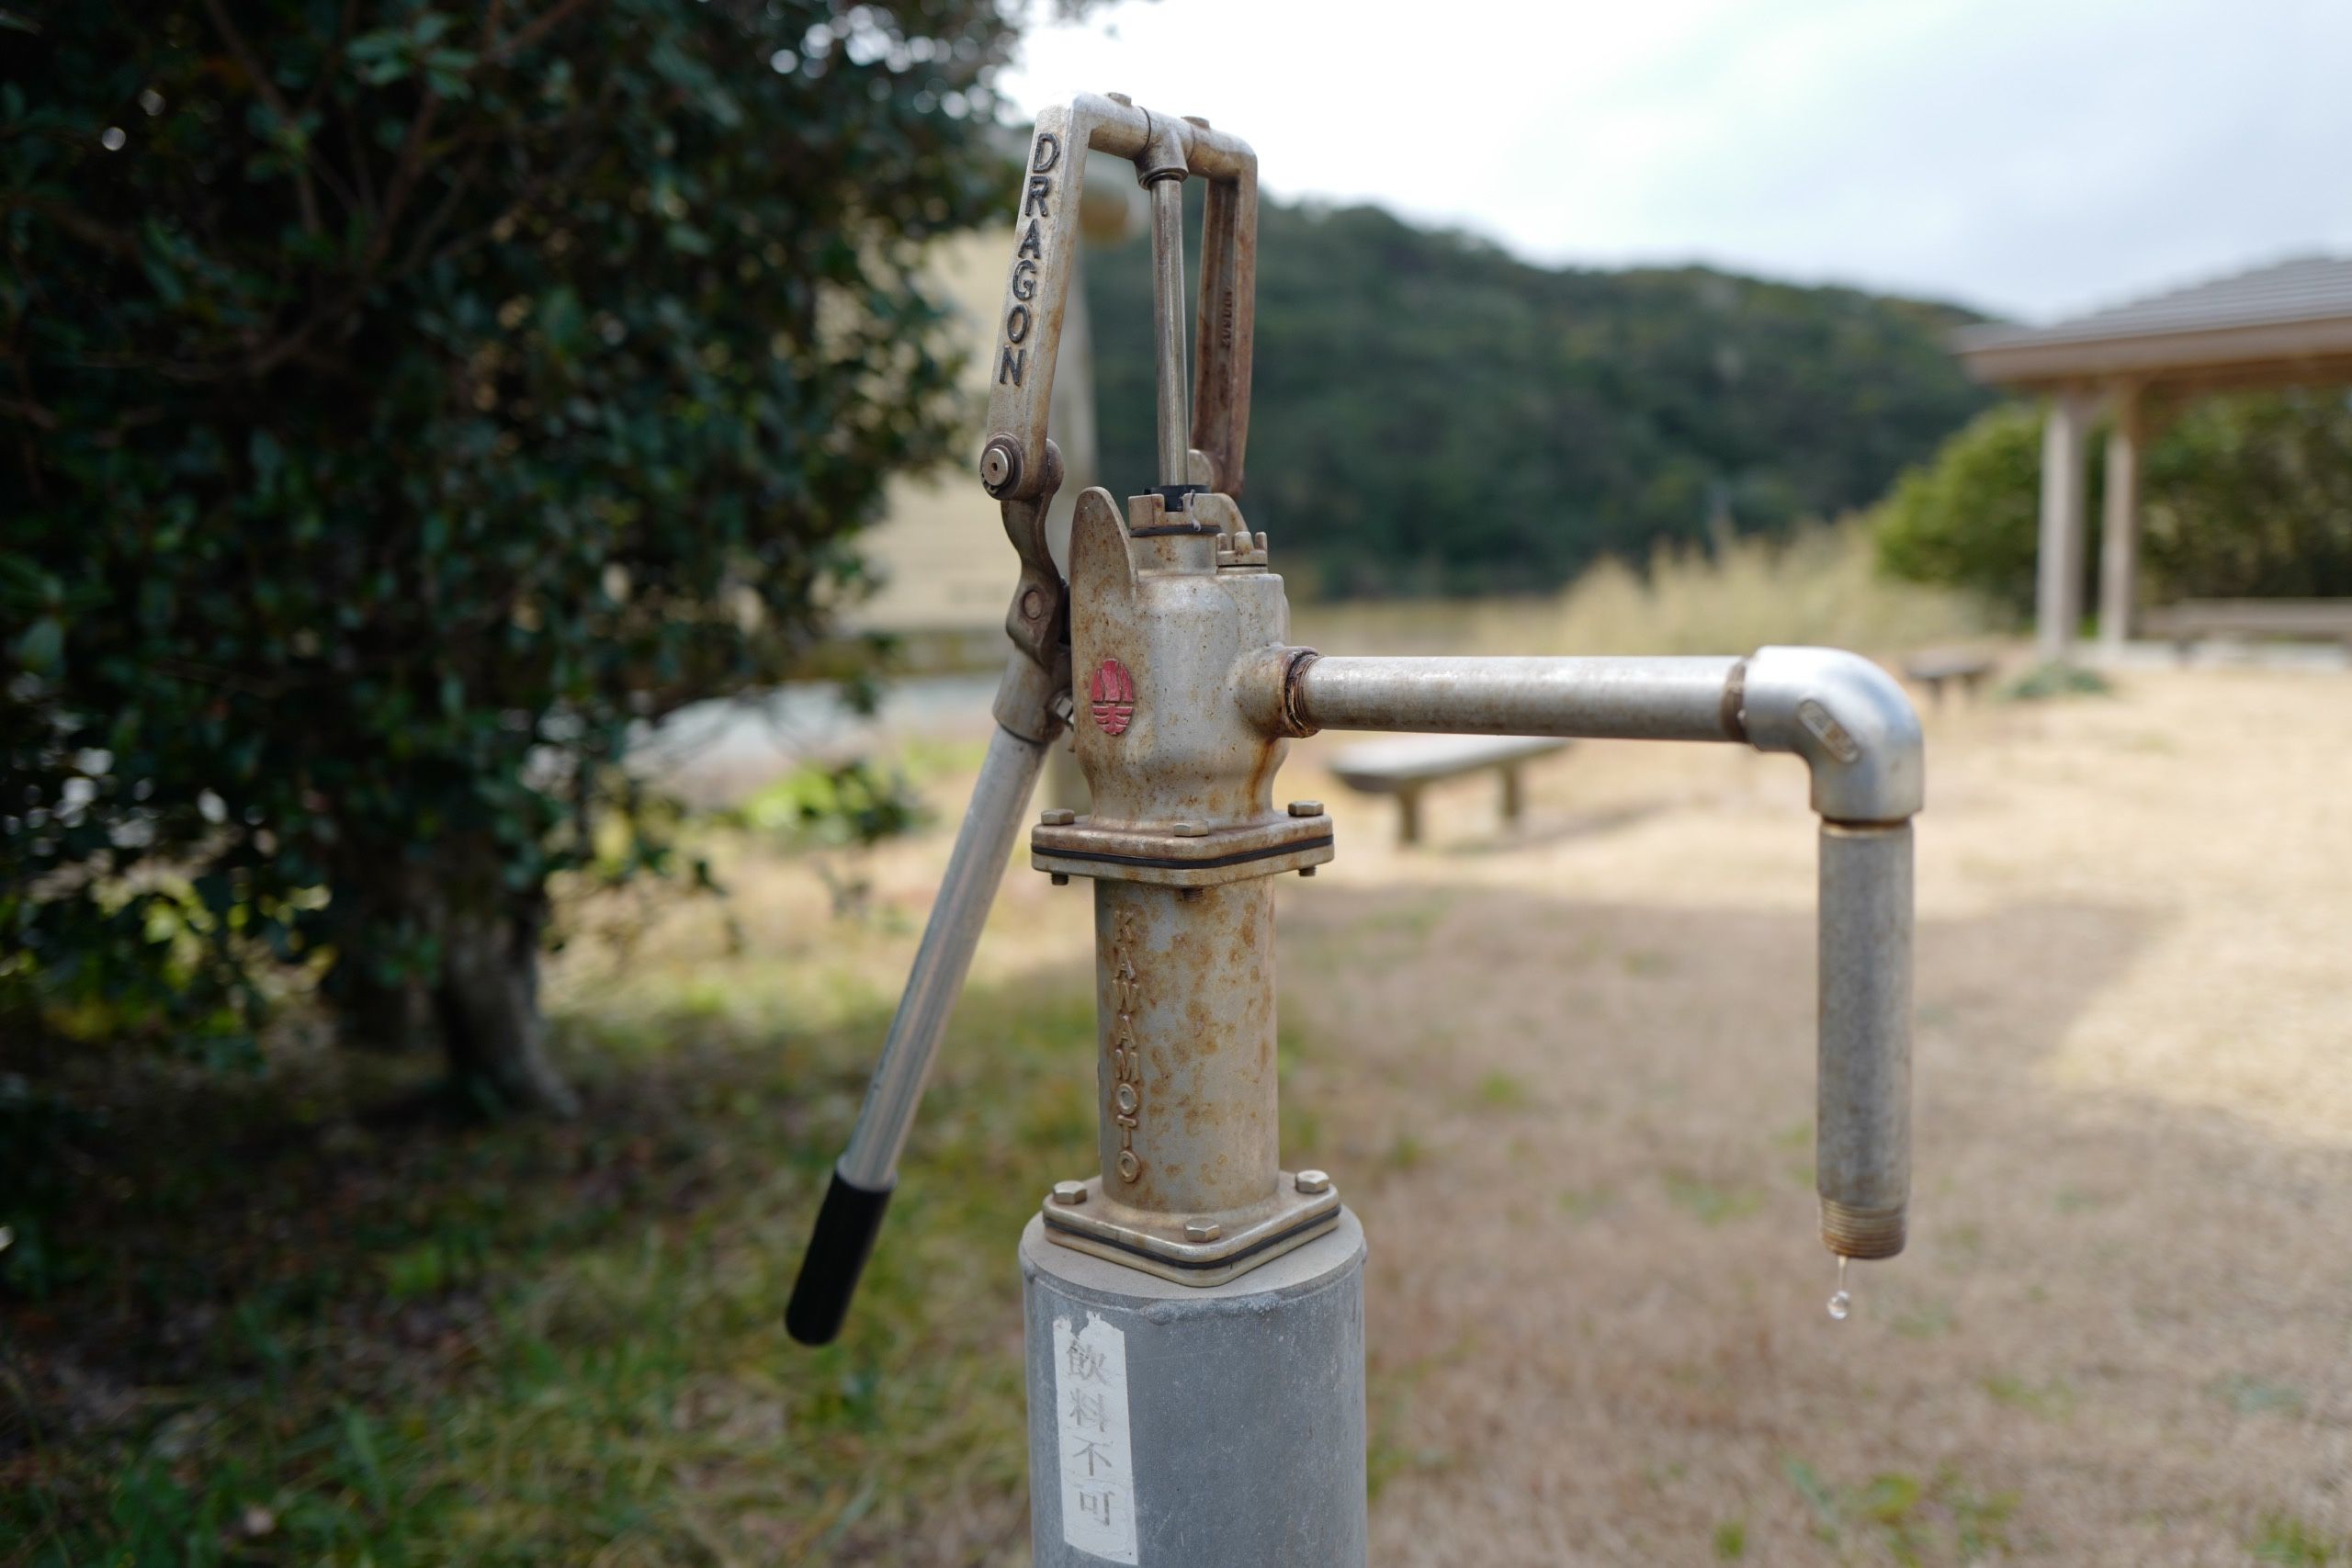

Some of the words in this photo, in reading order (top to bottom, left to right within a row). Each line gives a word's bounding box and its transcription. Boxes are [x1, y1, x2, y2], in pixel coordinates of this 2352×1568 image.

[999, 132, 1060, 386] DRAGON
[1113, 910, 1140, 1182] KAWAMOTO
[1067, 1339, 1113, 1526] 飲料不可
